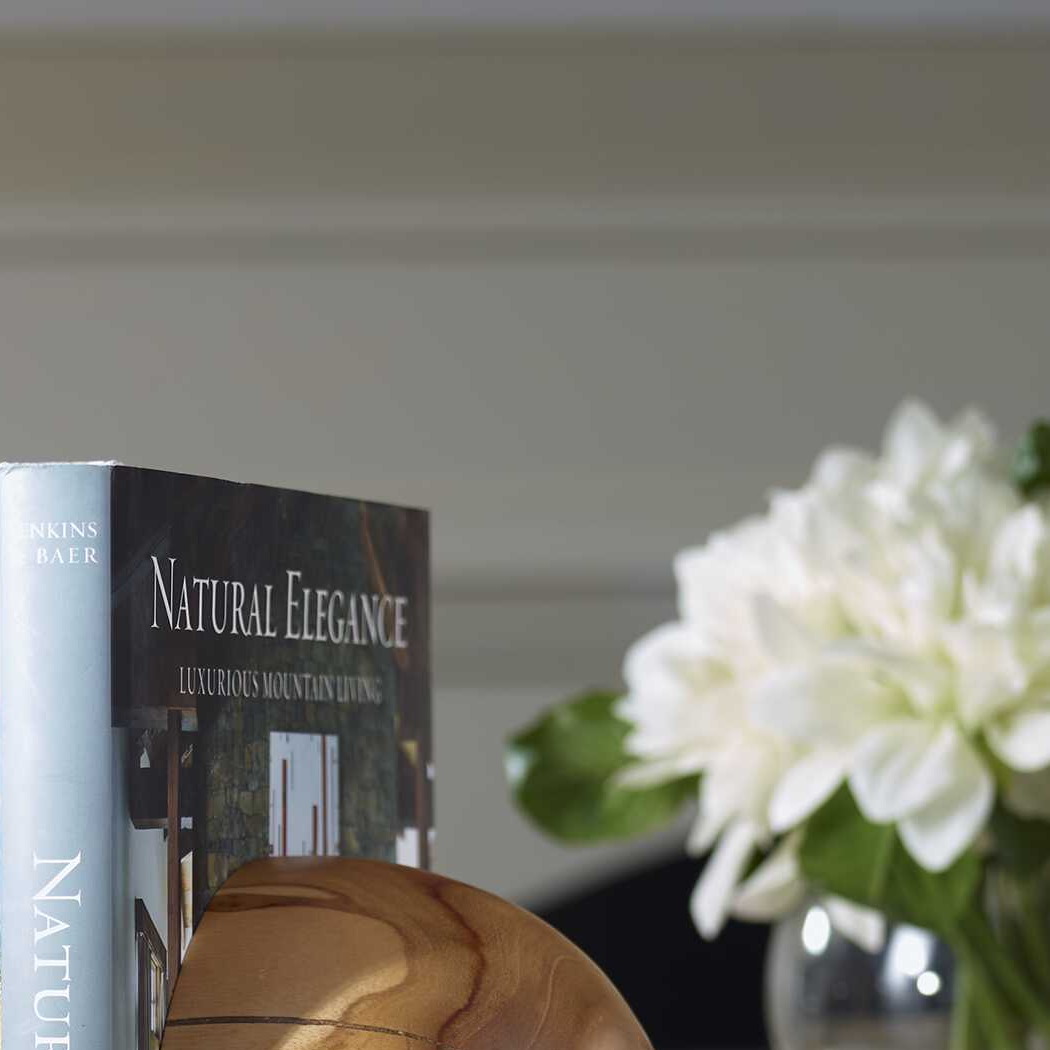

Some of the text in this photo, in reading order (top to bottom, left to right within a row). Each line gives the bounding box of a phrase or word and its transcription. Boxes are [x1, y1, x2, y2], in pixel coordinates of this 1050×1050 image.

[23, 521, 99, 539] NKINS
[37, 547, 98, 565] BAER
[150, 555, 409, 649] NATURAL ELEGANCE
[179, 666, 383, 705] LUXURIOUS MOUNTAIN LIVING
